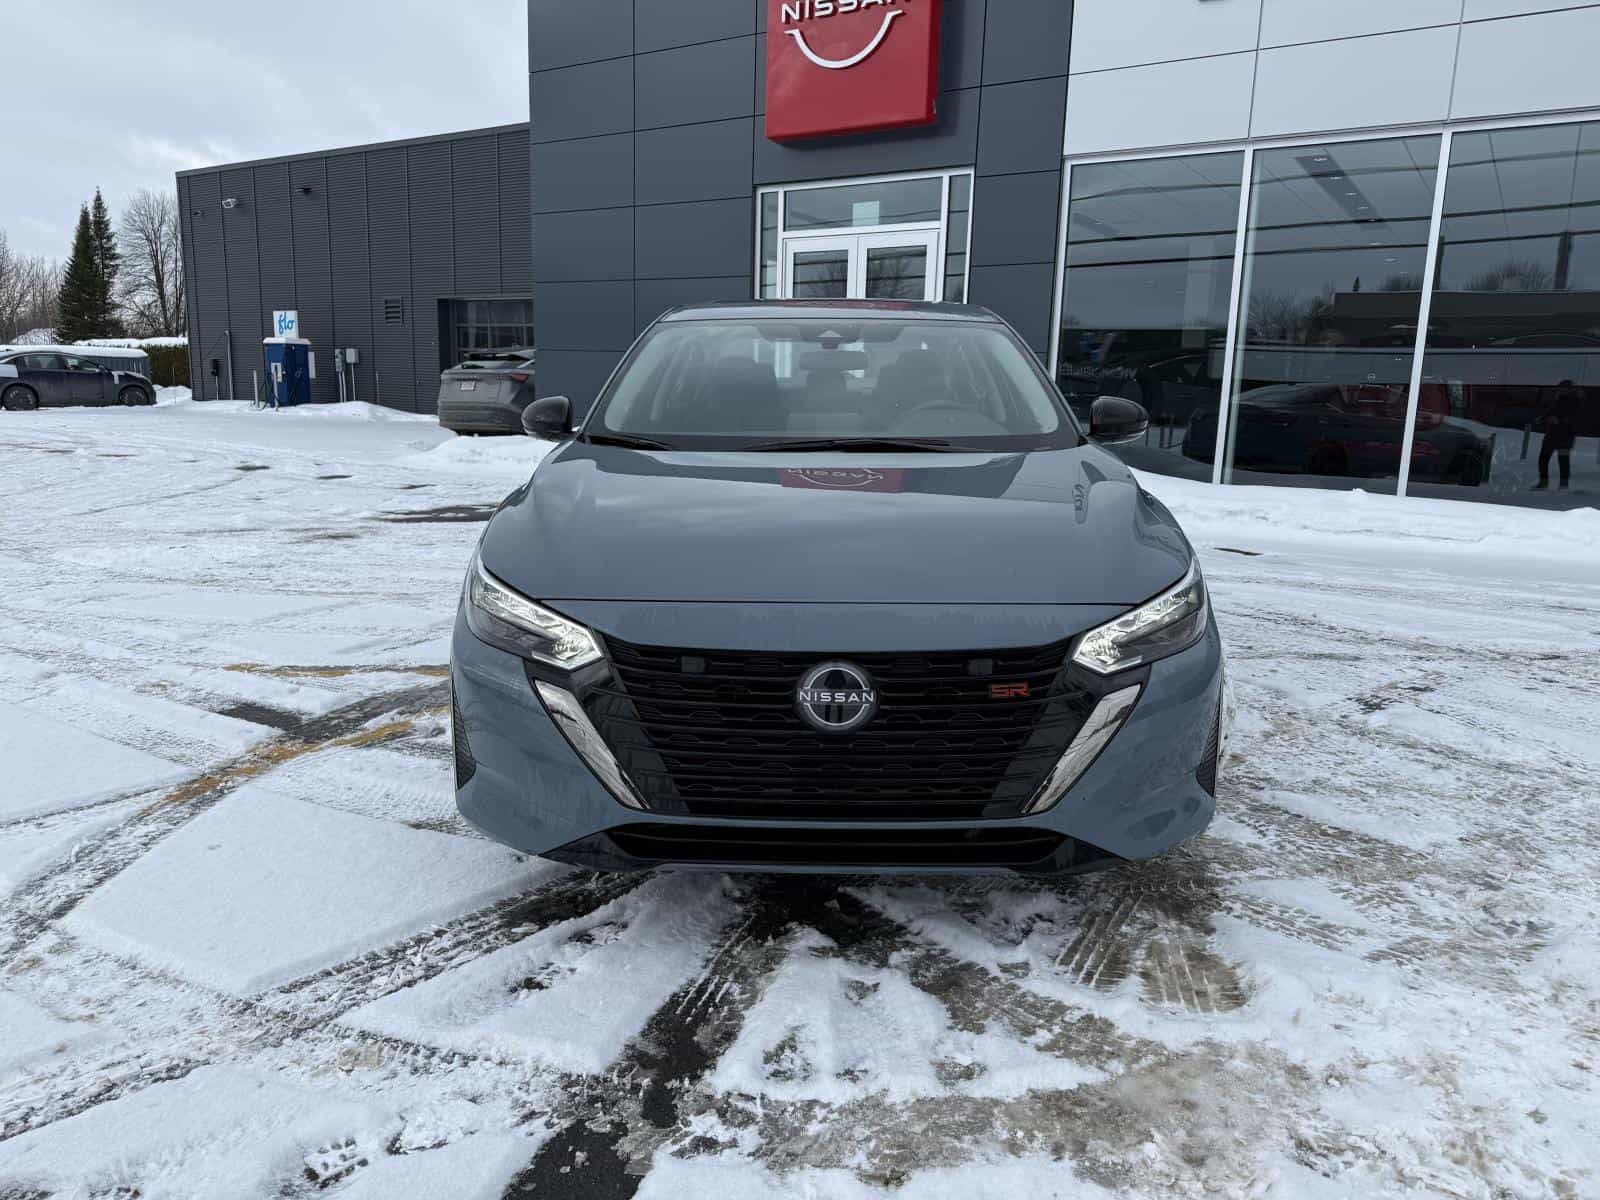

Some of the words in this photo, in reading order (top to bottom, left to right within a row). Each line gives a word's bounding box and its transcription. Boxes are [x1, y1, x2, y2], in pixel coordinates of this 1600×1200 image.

[781, 0, 893, 23] NISS
[278, 312, 295, 335] flo
[800, 690, 874, 703] NISSAN
[991, 682, 1028, 698] SR
